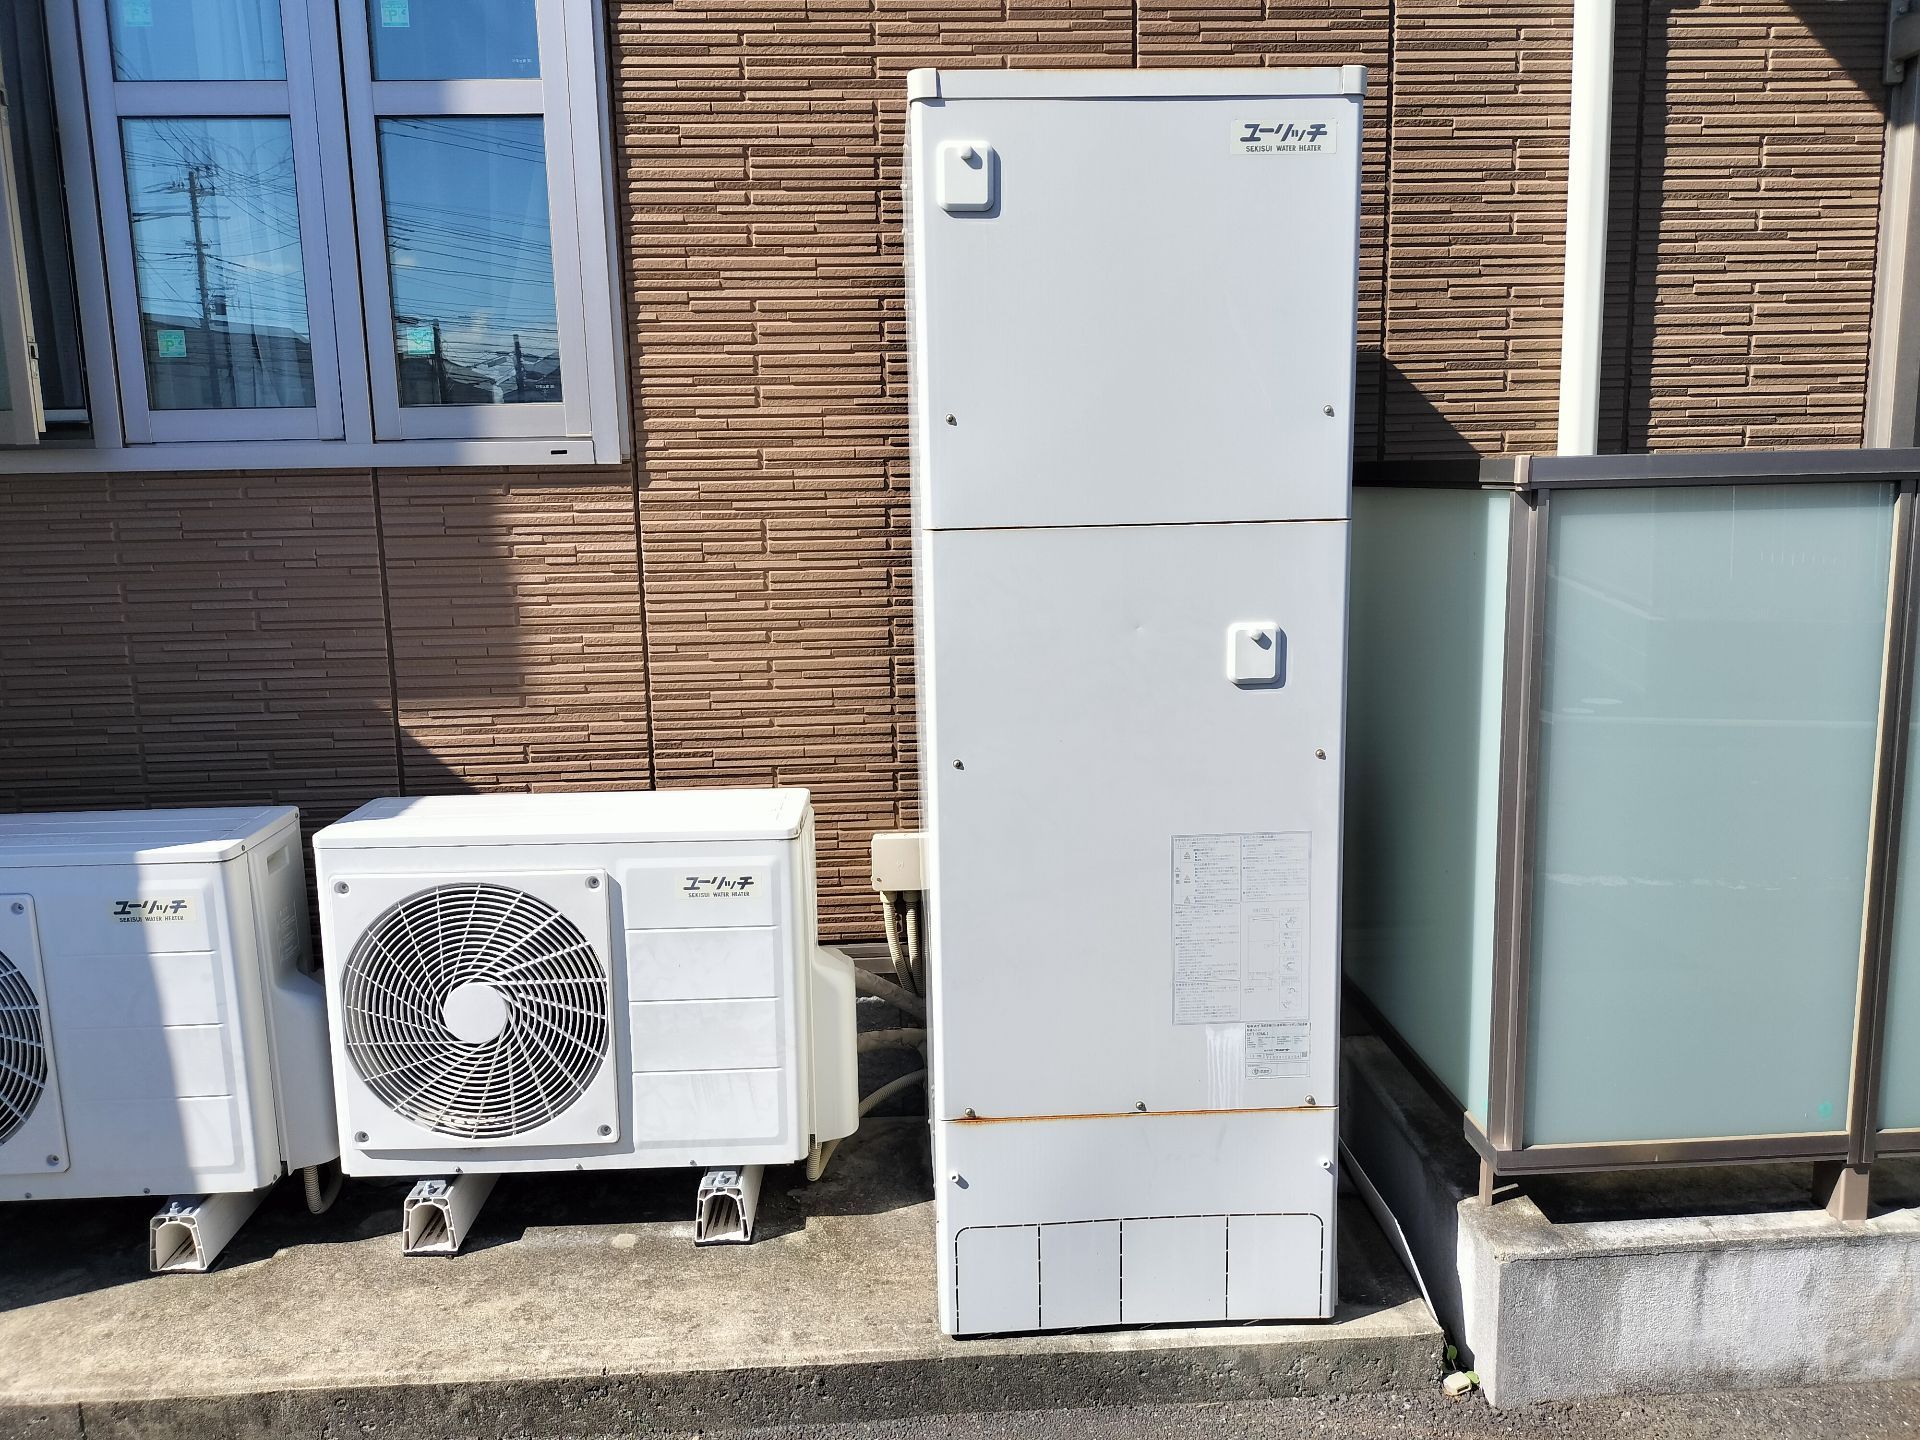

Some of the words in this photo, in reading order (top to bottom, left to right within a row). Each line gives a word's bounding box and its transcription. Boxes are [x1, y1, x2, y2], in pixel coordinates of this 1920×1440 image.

[1240, 124, 1327, 142] ユーリッチ
[1245, 145, 1273, 153] SEKISUI
[1276, 144, 1297, 152] WATER
[1298, 144, 1322, 152] HEATER
[683, 876, 754, 890] ユーリッチ
[113, 900, 187, 915] ユーリッチ
